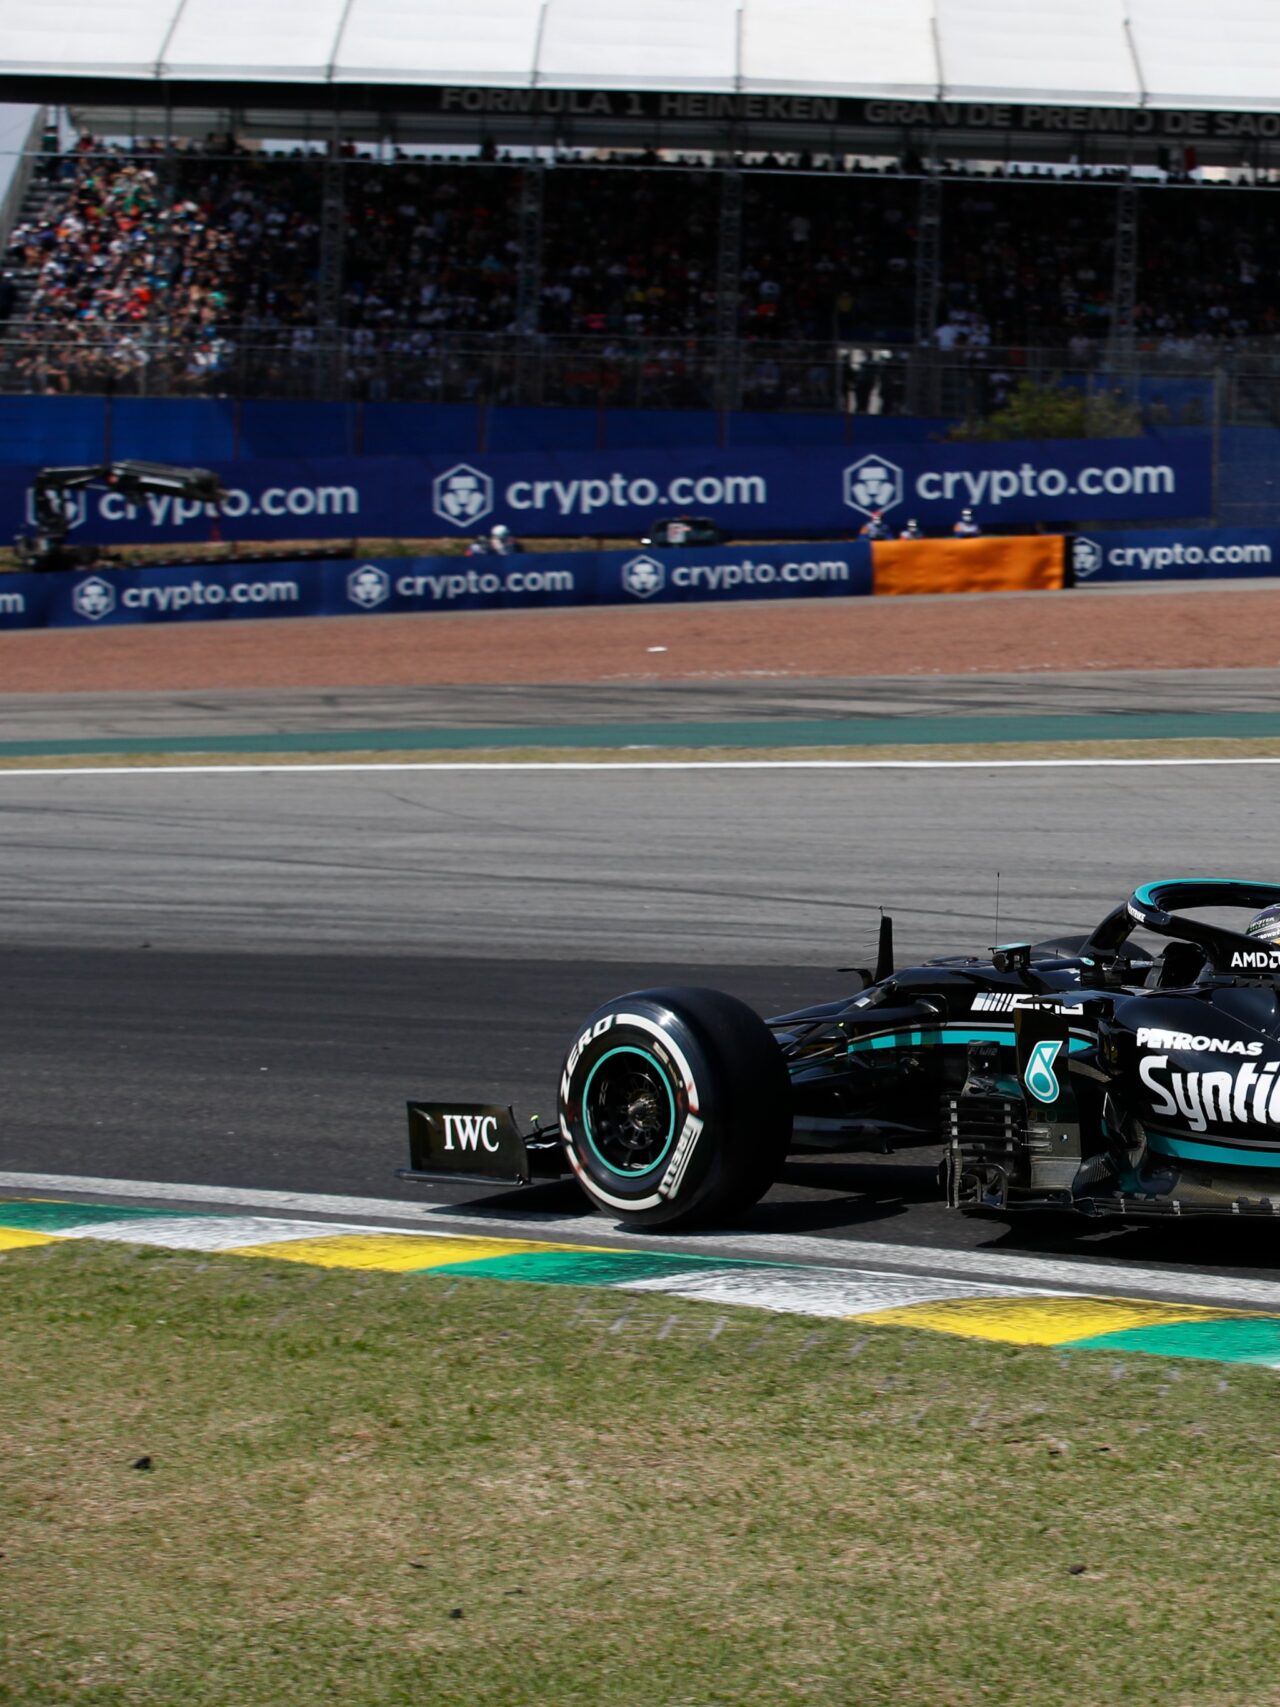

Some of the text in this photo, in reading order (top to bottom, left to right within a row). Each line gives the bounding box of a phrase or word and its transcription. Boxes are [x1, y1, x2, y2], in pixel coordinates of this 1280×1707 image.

[441, 87, 611, 114] FORMULA
[625, 92, 646, 116] 1
[659, 96, 839, 122] HEINEKEN
[864, 101, 1011, 126] GRANDE
[1163, 112, 1207, 134] DE
[506, 473, 766, 514] crypto.com
[916, 463, 1175, 505] crypto.com
[1108, 534, 1272, 570] crypto.com
[397, 569, 574, 600] crypto.com
[671, 560, 849, 589] crypto.com
[122, 580, 298, 611] crypto.com
[1230, 951, 1270, 968] AMD
[560, 1013, 615, 1105] ZERO
[1136, 1027, 1265, 1057] PETRONAS
[442, 1114, 500, 1153] IWC
[657, 1112, 704, 1200] PIRELLI
